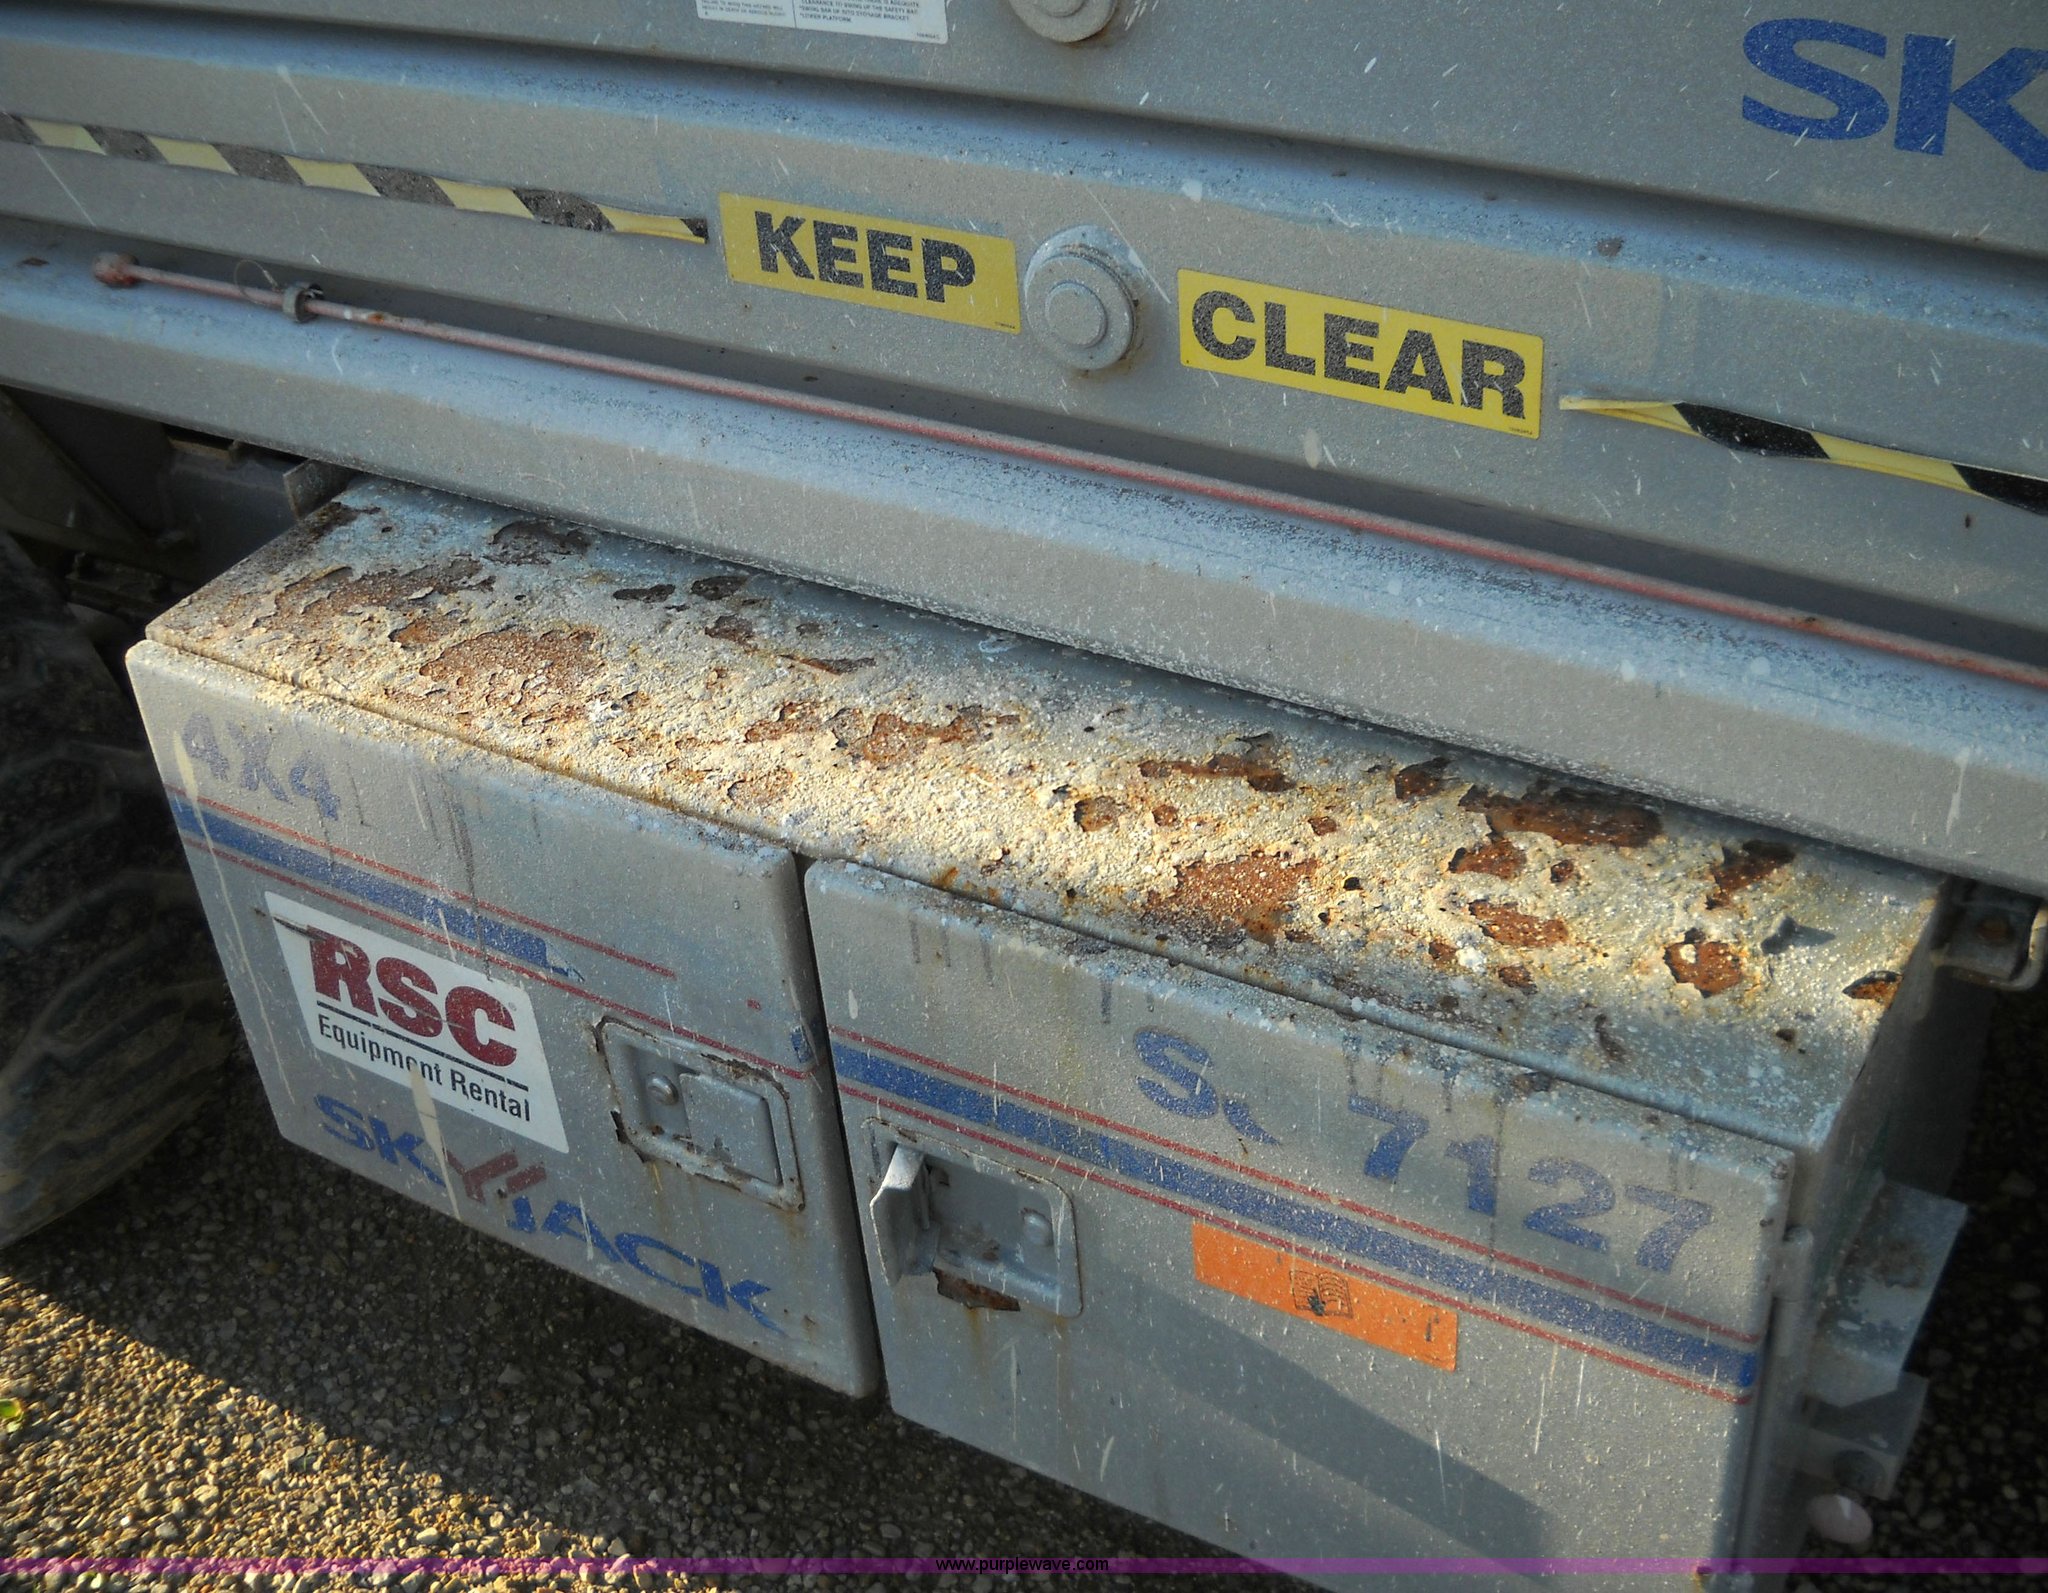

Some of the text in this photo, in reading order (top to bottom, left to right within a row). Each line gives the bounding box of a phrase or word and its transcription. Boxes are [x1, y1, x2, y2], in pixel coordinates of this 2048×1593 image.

[755, 211, 1526, 420] KEEP CLEAR
[306, 925, 517, 1067] RSC
[450, 1068, 531, 1123] Rental
[1350, 1093, 1712, 1273] 7127
